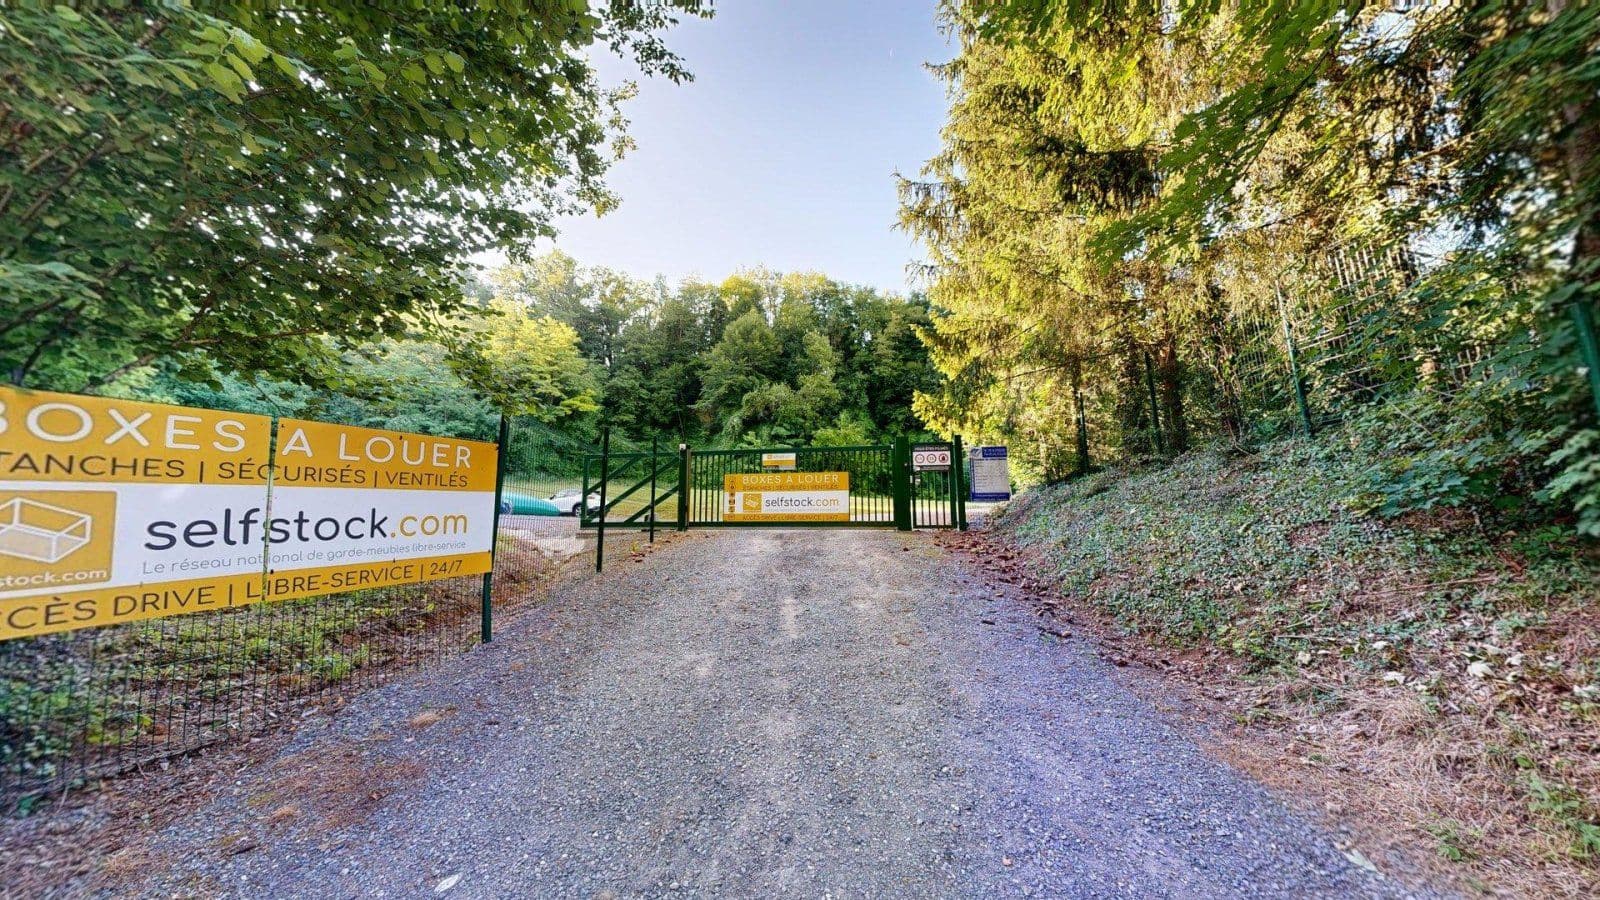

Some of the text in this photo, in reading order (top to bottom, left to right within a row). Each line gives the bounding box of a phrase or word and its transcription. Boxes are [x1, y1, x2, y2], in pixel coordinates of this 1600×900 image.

[0, 402, 471, 469] OXES A LOUER
[218, 457, 366, 485] SÉCURISÉS
[386, 471, 468, 488] VENTILÉS
[743, 474, 839, 485] BOXES A LOUER
[765, 497, 839, 507] selfstock.com
[144, 506, 468, 551] selfstock.com
[142, 541, 466, 575] Le réseau national de garde-meubles libre-service
[0, 596, 97, 629] CÈS
[113, 585, 215, 616] DRIVE
[246, 564, 414, 599] LIBRE-SERVICE
[430, 560, 463, 576] 24/7
